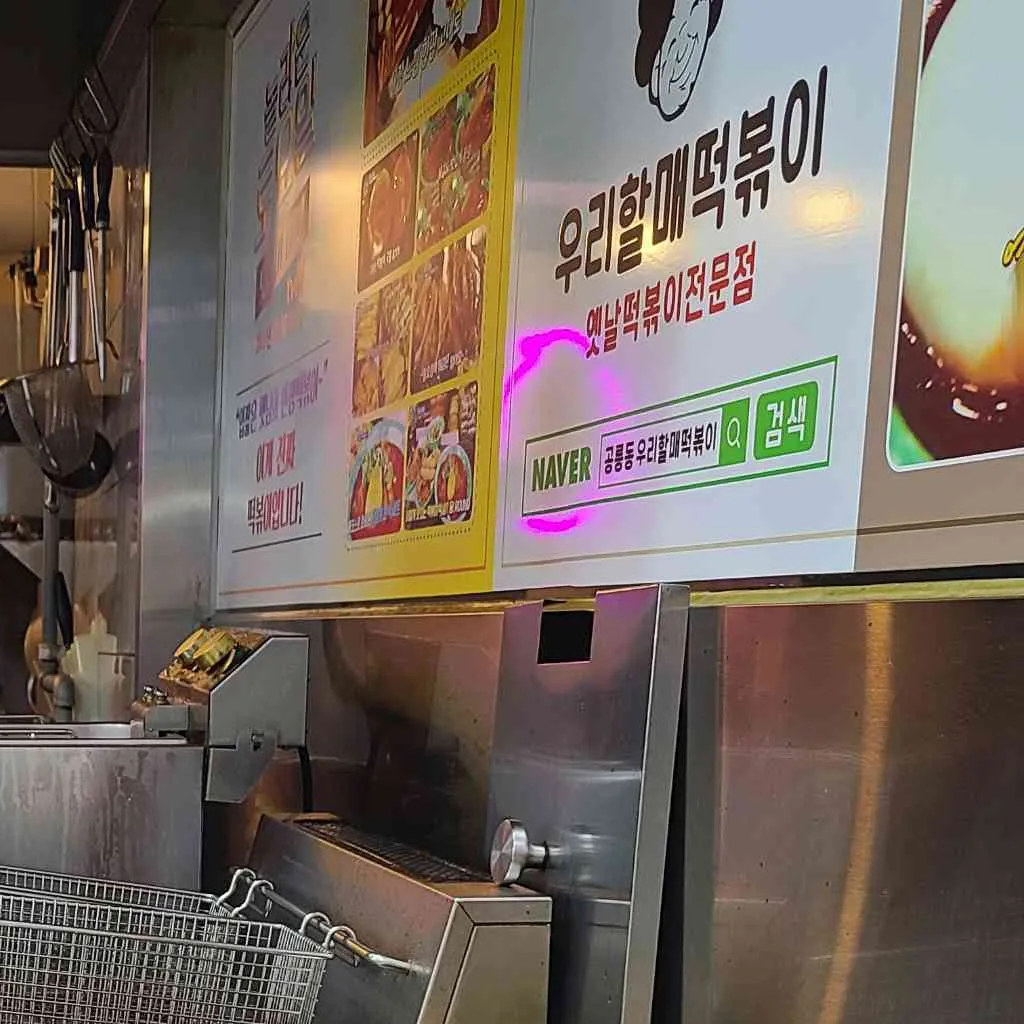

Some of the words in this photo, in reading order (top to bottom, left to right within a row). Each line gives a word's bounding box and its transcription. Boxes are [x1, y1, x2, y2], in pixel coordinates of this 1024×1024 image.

[555, 65, 827, 293] 우리할매떡볶이
[585, 240, 756, 359] 옛날떡볶이전문점
[604, 422, 718, 475] 공릉동우리할매떡볶이
[765, 396, 807, 449] 검색
[531, 447, 592, 492] NAVER
[248, 481, 303, 535] 떡볶이입니다!
